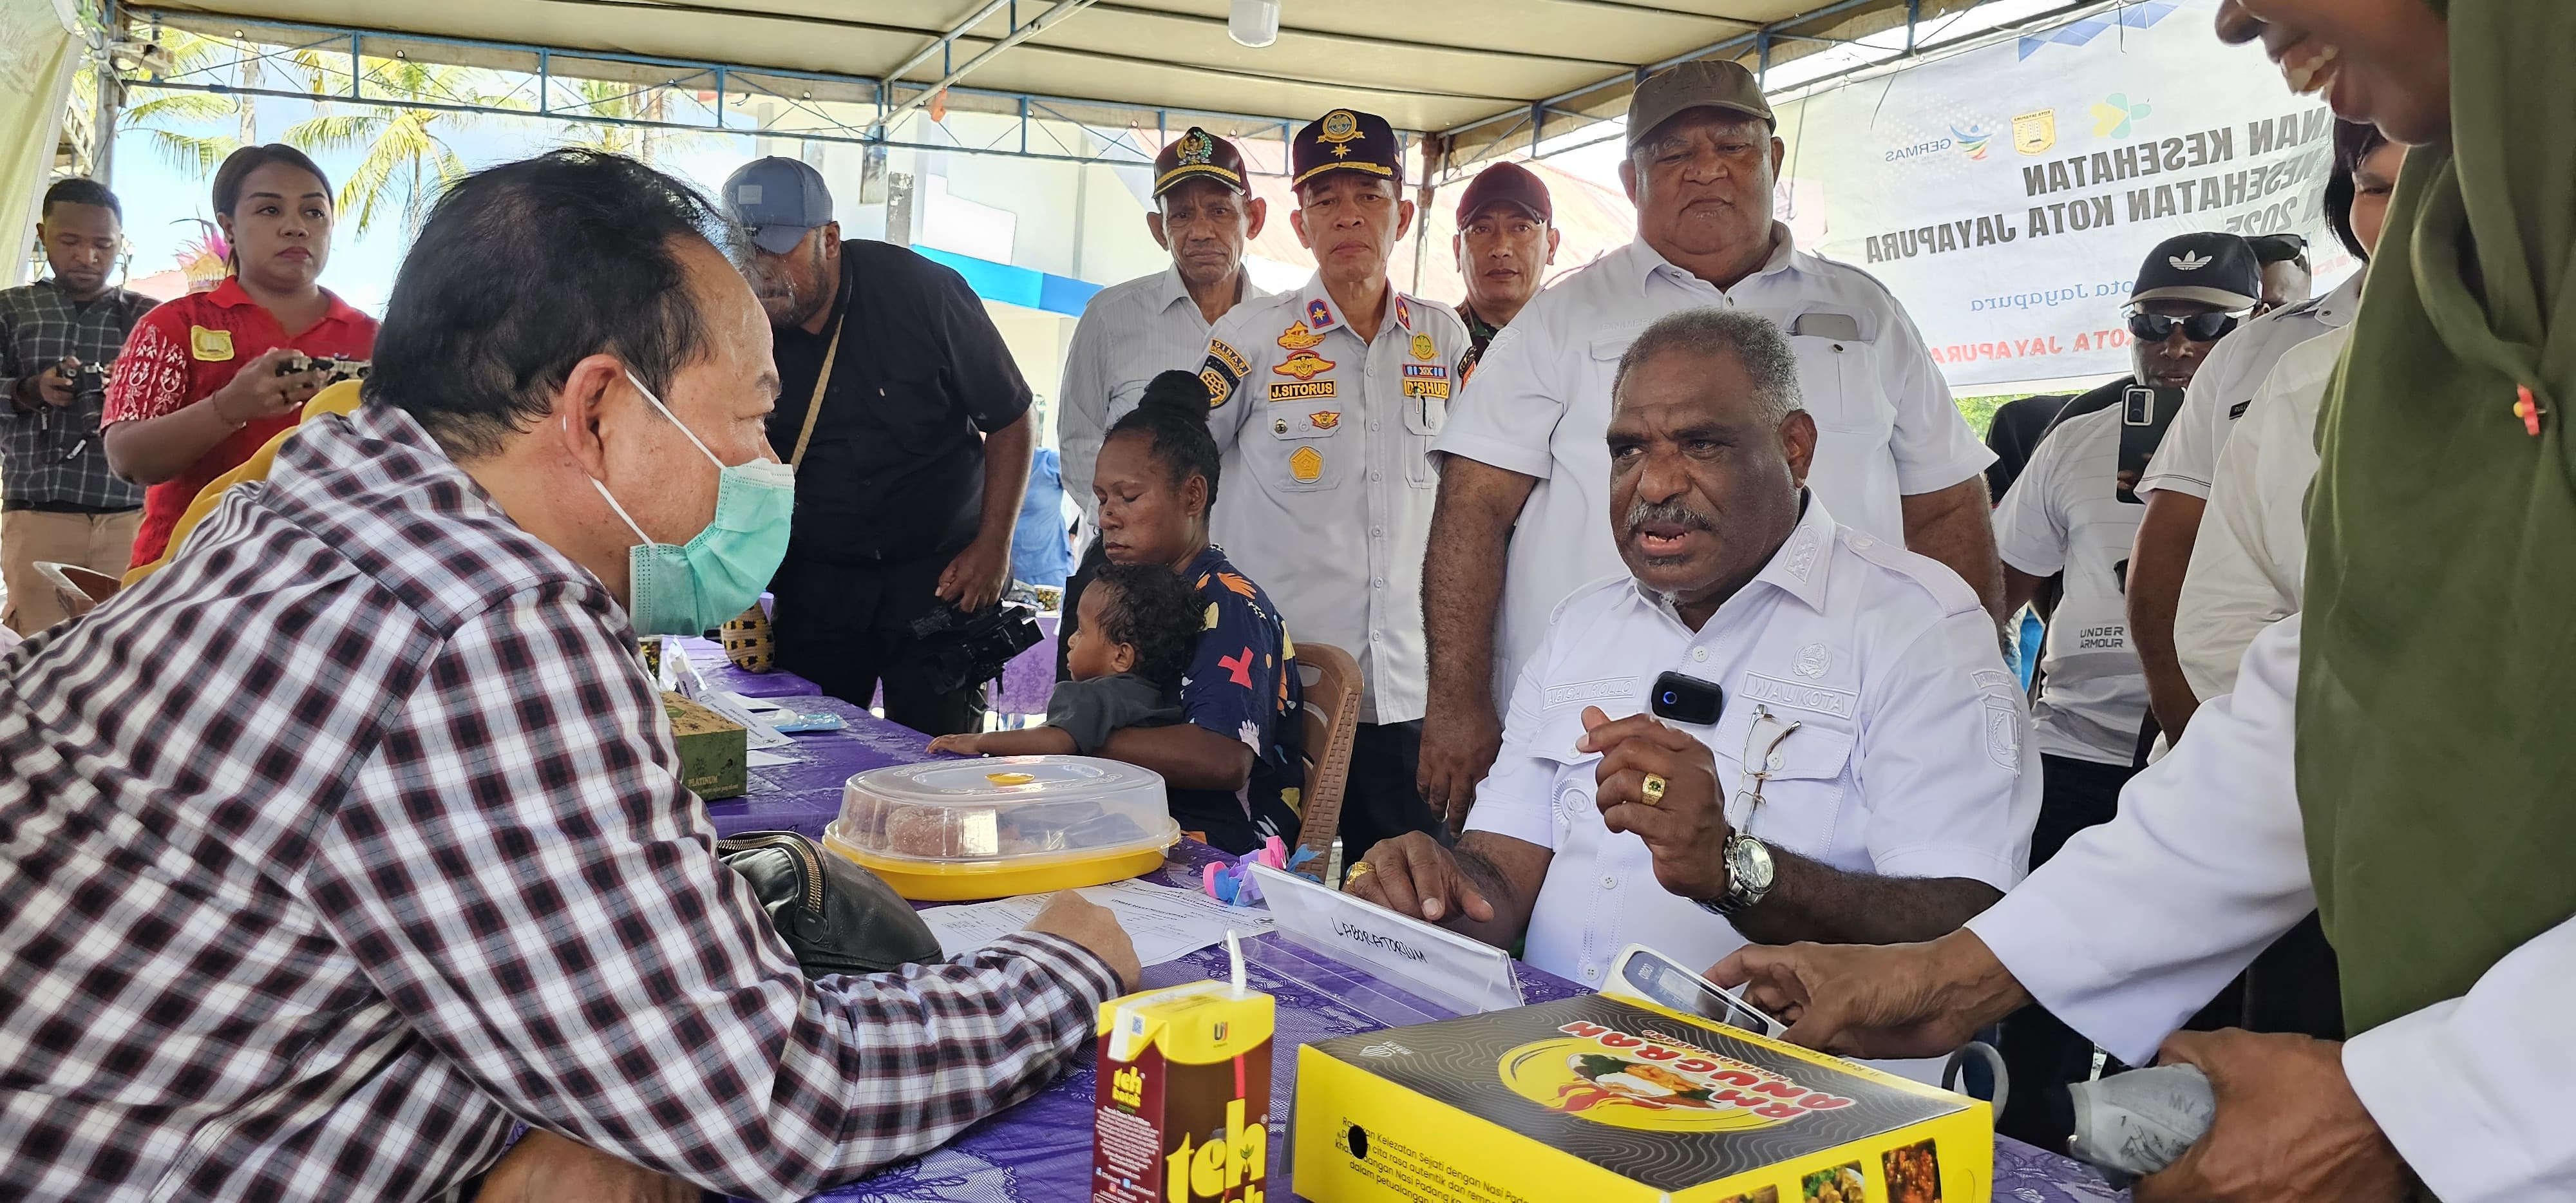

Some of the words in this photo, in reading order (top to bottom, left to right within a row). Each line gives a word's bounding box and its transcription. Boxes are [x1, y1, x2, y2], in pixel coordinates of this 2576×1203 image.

[1272, 382, 1333, 398] J.SITORUS
[2080, 627, 2124, 638] UNDER
[2080, 638, 2123, 649] ARMOUR
[1591, 680, 1633, 697] ROLLO
[687, 775, 718, 787] PLATINUM
[1331, 916, 1428, 964] LABORATORIUM
[1642, 1030, 1707, 1054] PADANG
[1113, 1066, 1142, 1095] teh
[1706, 1053, 1791, 1083] MASAKAN
[1166, 1098, 1267, 1203] teh
[1372, 1146, 1388, 1159] cita
[1389, 1154, 1408, 1169] rasa
[1410, 1164, 1446, 1186] autentik
[1448, 1180, 1466, 1195] dan
[1377, 1133, 1417, 1159] Kelezatan
[1419, 1152, 1444, 1171] Sejati
[1446, 1166, 1481, 1188] dengan
[1483, 1180, 1504, 1198] Nasi
[1349, 1160, 1374, 1179] dalam
[1376, 1175, 1429, 1203] petualangan
[1396, 1169, 1414, 1185] Nasi
[1416, 1178, 1450, 1202] Padang
